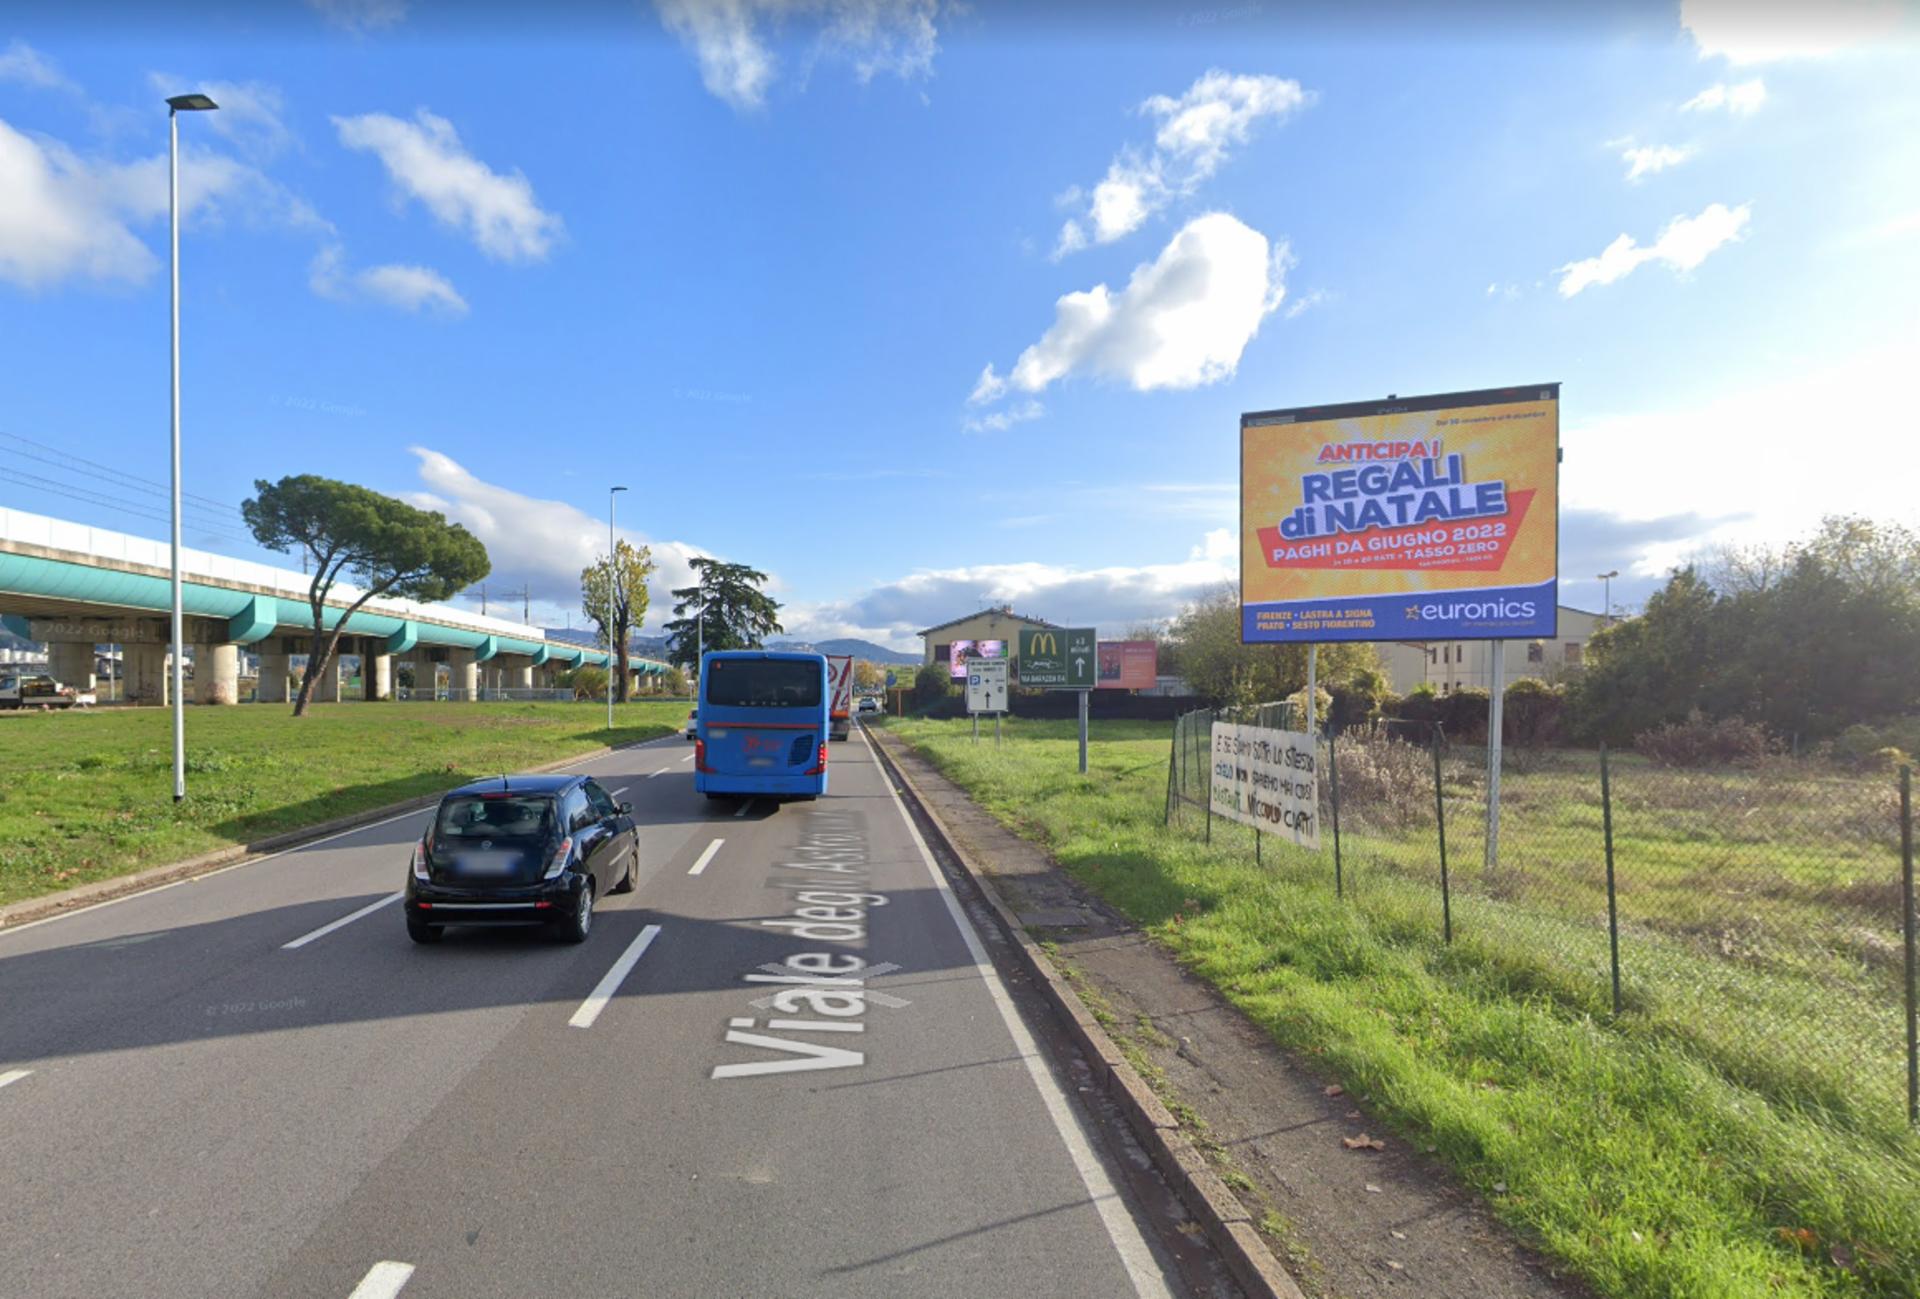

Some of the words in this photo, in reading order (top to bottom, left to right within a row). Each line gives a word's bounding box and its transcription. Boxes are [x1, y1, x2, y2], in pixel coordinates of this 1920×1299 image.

[1318, 440, 1426, 461] ANTICIPA
[1302, 454, 1461, 504] REGALI
[1280, 506, 1316, 538] di
[1324, 482, 1506, 532] NATALE
[1273, 543, 1332, 562] PAGHI
[1336, 540, 1364, 555] DA
[1367, 530, 1448, 550] GIUGNO
[1452, 523, 1507, 542] 2022
[1404, 545, 1455, 560] TASSO
[1457, 540, 1499, 555] ZERO
[1300, 610, 1334, 619] LASTRA
[1421, 597, 1536, 620] euronics
[1292, 621, 1320, 630] SESTO
